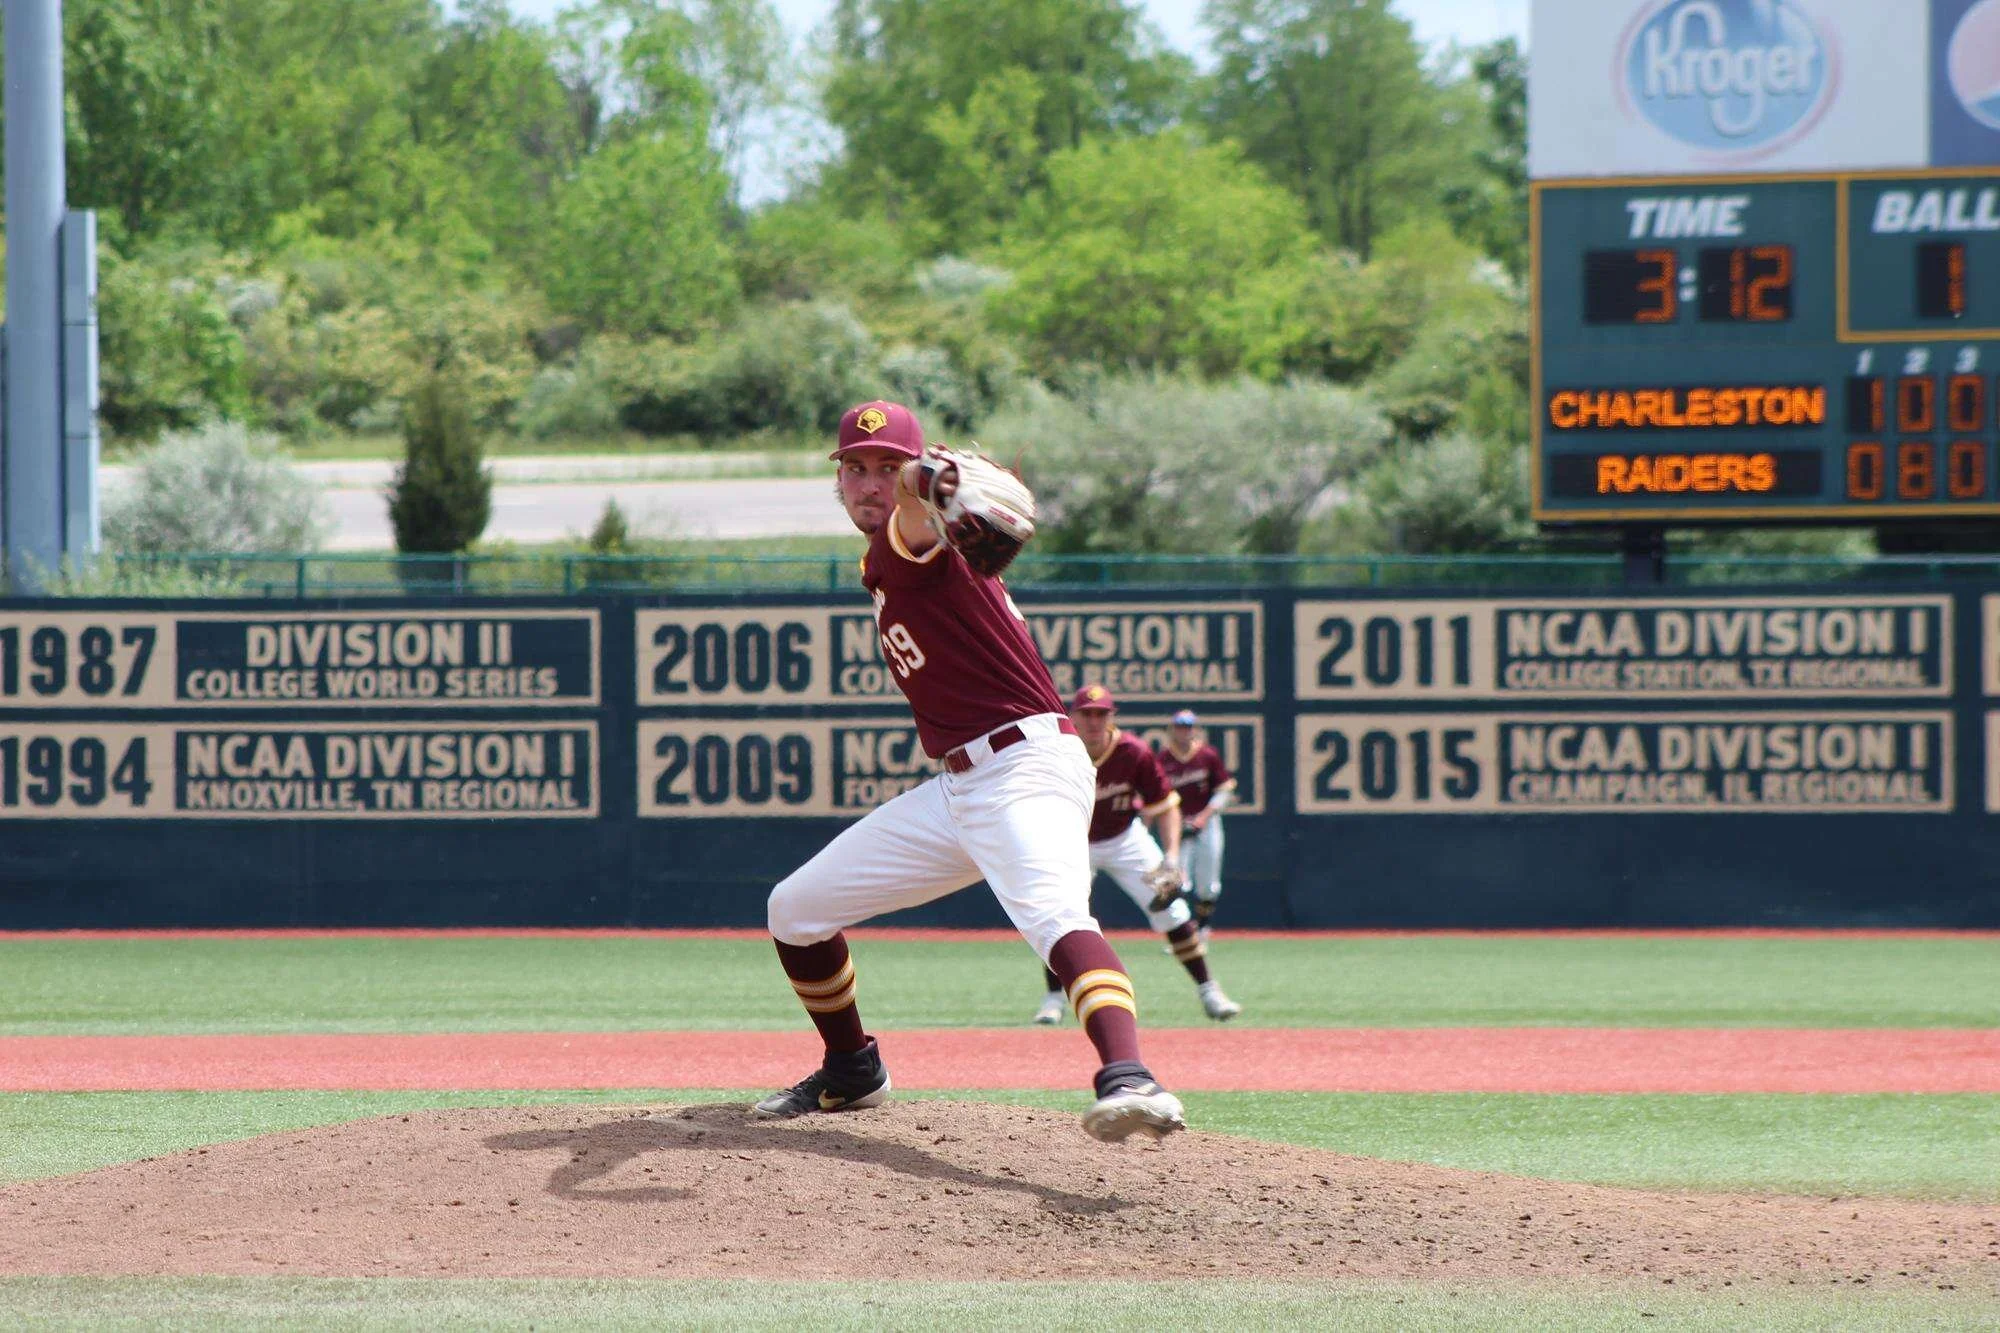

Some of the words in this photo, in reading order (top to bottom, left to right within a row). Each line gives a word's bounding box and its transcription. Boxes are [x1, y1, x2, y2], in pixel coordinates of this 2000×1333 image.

[1643, 2, 1819, 137] Kroger
[1626, 196, 1749, 239] TIME
[1947, 245, 1965, 313] 1
[1856, 349, 1873, 375] 1
[1903, 348, 1931, 375] 2
[1954, 345, 1981, 374] 3
[1550, 387, 1826, 428] CHARLESTON
[1597, 454, 1777, 493] RAIDERS
[246, 624, 464, 666] DIVISION
[479, 624, 512, 664] II
[881, 623, 926, 678] 39
[1033, 615, 1208, 660] VISION
[1223, 616, 1239, 657] I
[1315, 617, 1472, 687] 2011
[1504, 613, 1642, 657] NCAA
[1655, 610, 1894, 656] DIVISION
[1909, 609, 1926, 654] I
[0, 626, 157, 697] 1987
[652, 622, 812, 694] 2006
[1082, 660, 1242, 693] REGIONAL
[1503, 662, 1619, 690] COLLEGE
[1751, 661, 1785, 688] TX
[1790, 659, 1926, 687] REGIONAL
[186, 670, 318, 698] COLLEGE
[325, 670, 438, 698] WORLD
[445, 669, 558, 697] SERIES
[186, 735, 313, 777] NCAA
[326, 734, 546, 778] DIVISION
[559, 735, 574, 777] I
[654, 735, 813, 804] 2009
[1311, 731, 1482, 801] 2015
[1509, 728, 1648, 769] NCAA
[1658, 726, 1895, 770] DIVISION
[1910, 725, 1926, 769] I
[0, 737, 154, 807] 1994
[371, 781, 413, 809] TN
[423, 780, 578, 809] REGIONAL
[1723, 774, 1753, 801] IL
[1763, 772, 1930, 800] REGIONAL
